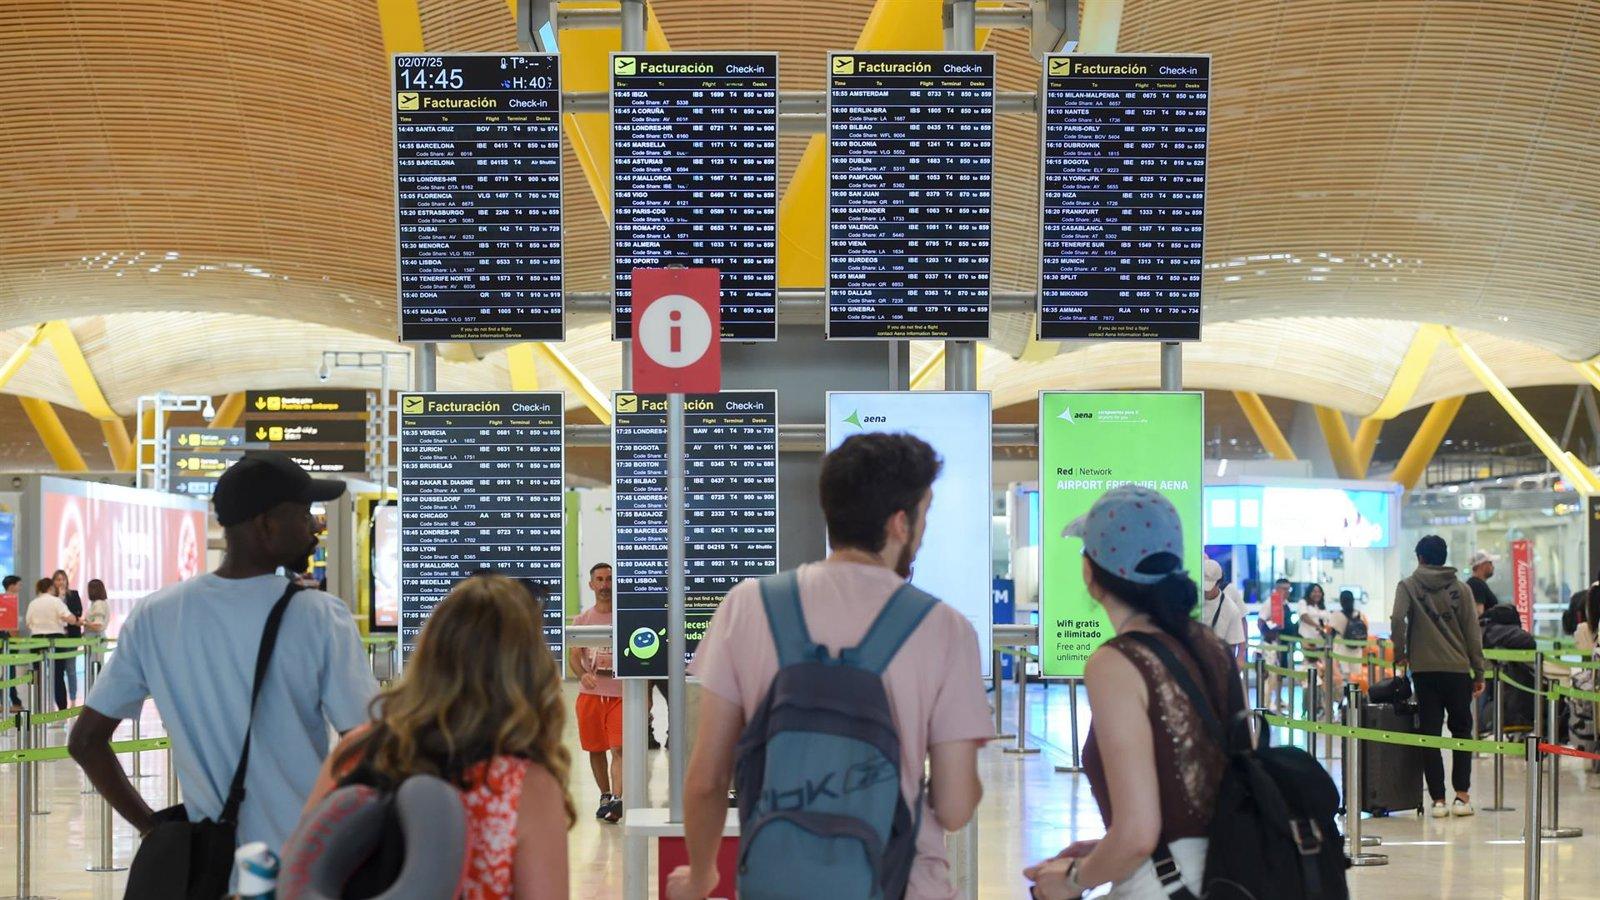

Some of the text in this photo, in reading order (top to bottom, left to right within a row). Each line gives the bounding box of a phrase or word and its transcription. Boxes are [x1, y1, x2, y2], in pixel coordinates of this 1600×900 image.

[398, 58, 443, 67] 02/07/25
[858, 62, 931, 72] Facturación
[640, 63, 764, 73] Facturación Check-in
[1075, 64, 1197, 75] Facturación Check-in
[401, 69, 463, 89] 14:45
[424, 97, 547, 108] Facturación Check-in
[428, 401, 500, 412] Facturación
[642, 400, 713, 410] Factación
[1057, 481, 1103, 489] AIRPORT
[1160, 481, 1188, 490] AENA
[1076, 620, 1099, 629] gratis
[1064, 630, 1101, 638] ilimitado
[1057, 653, 1089, 661] unlimite
